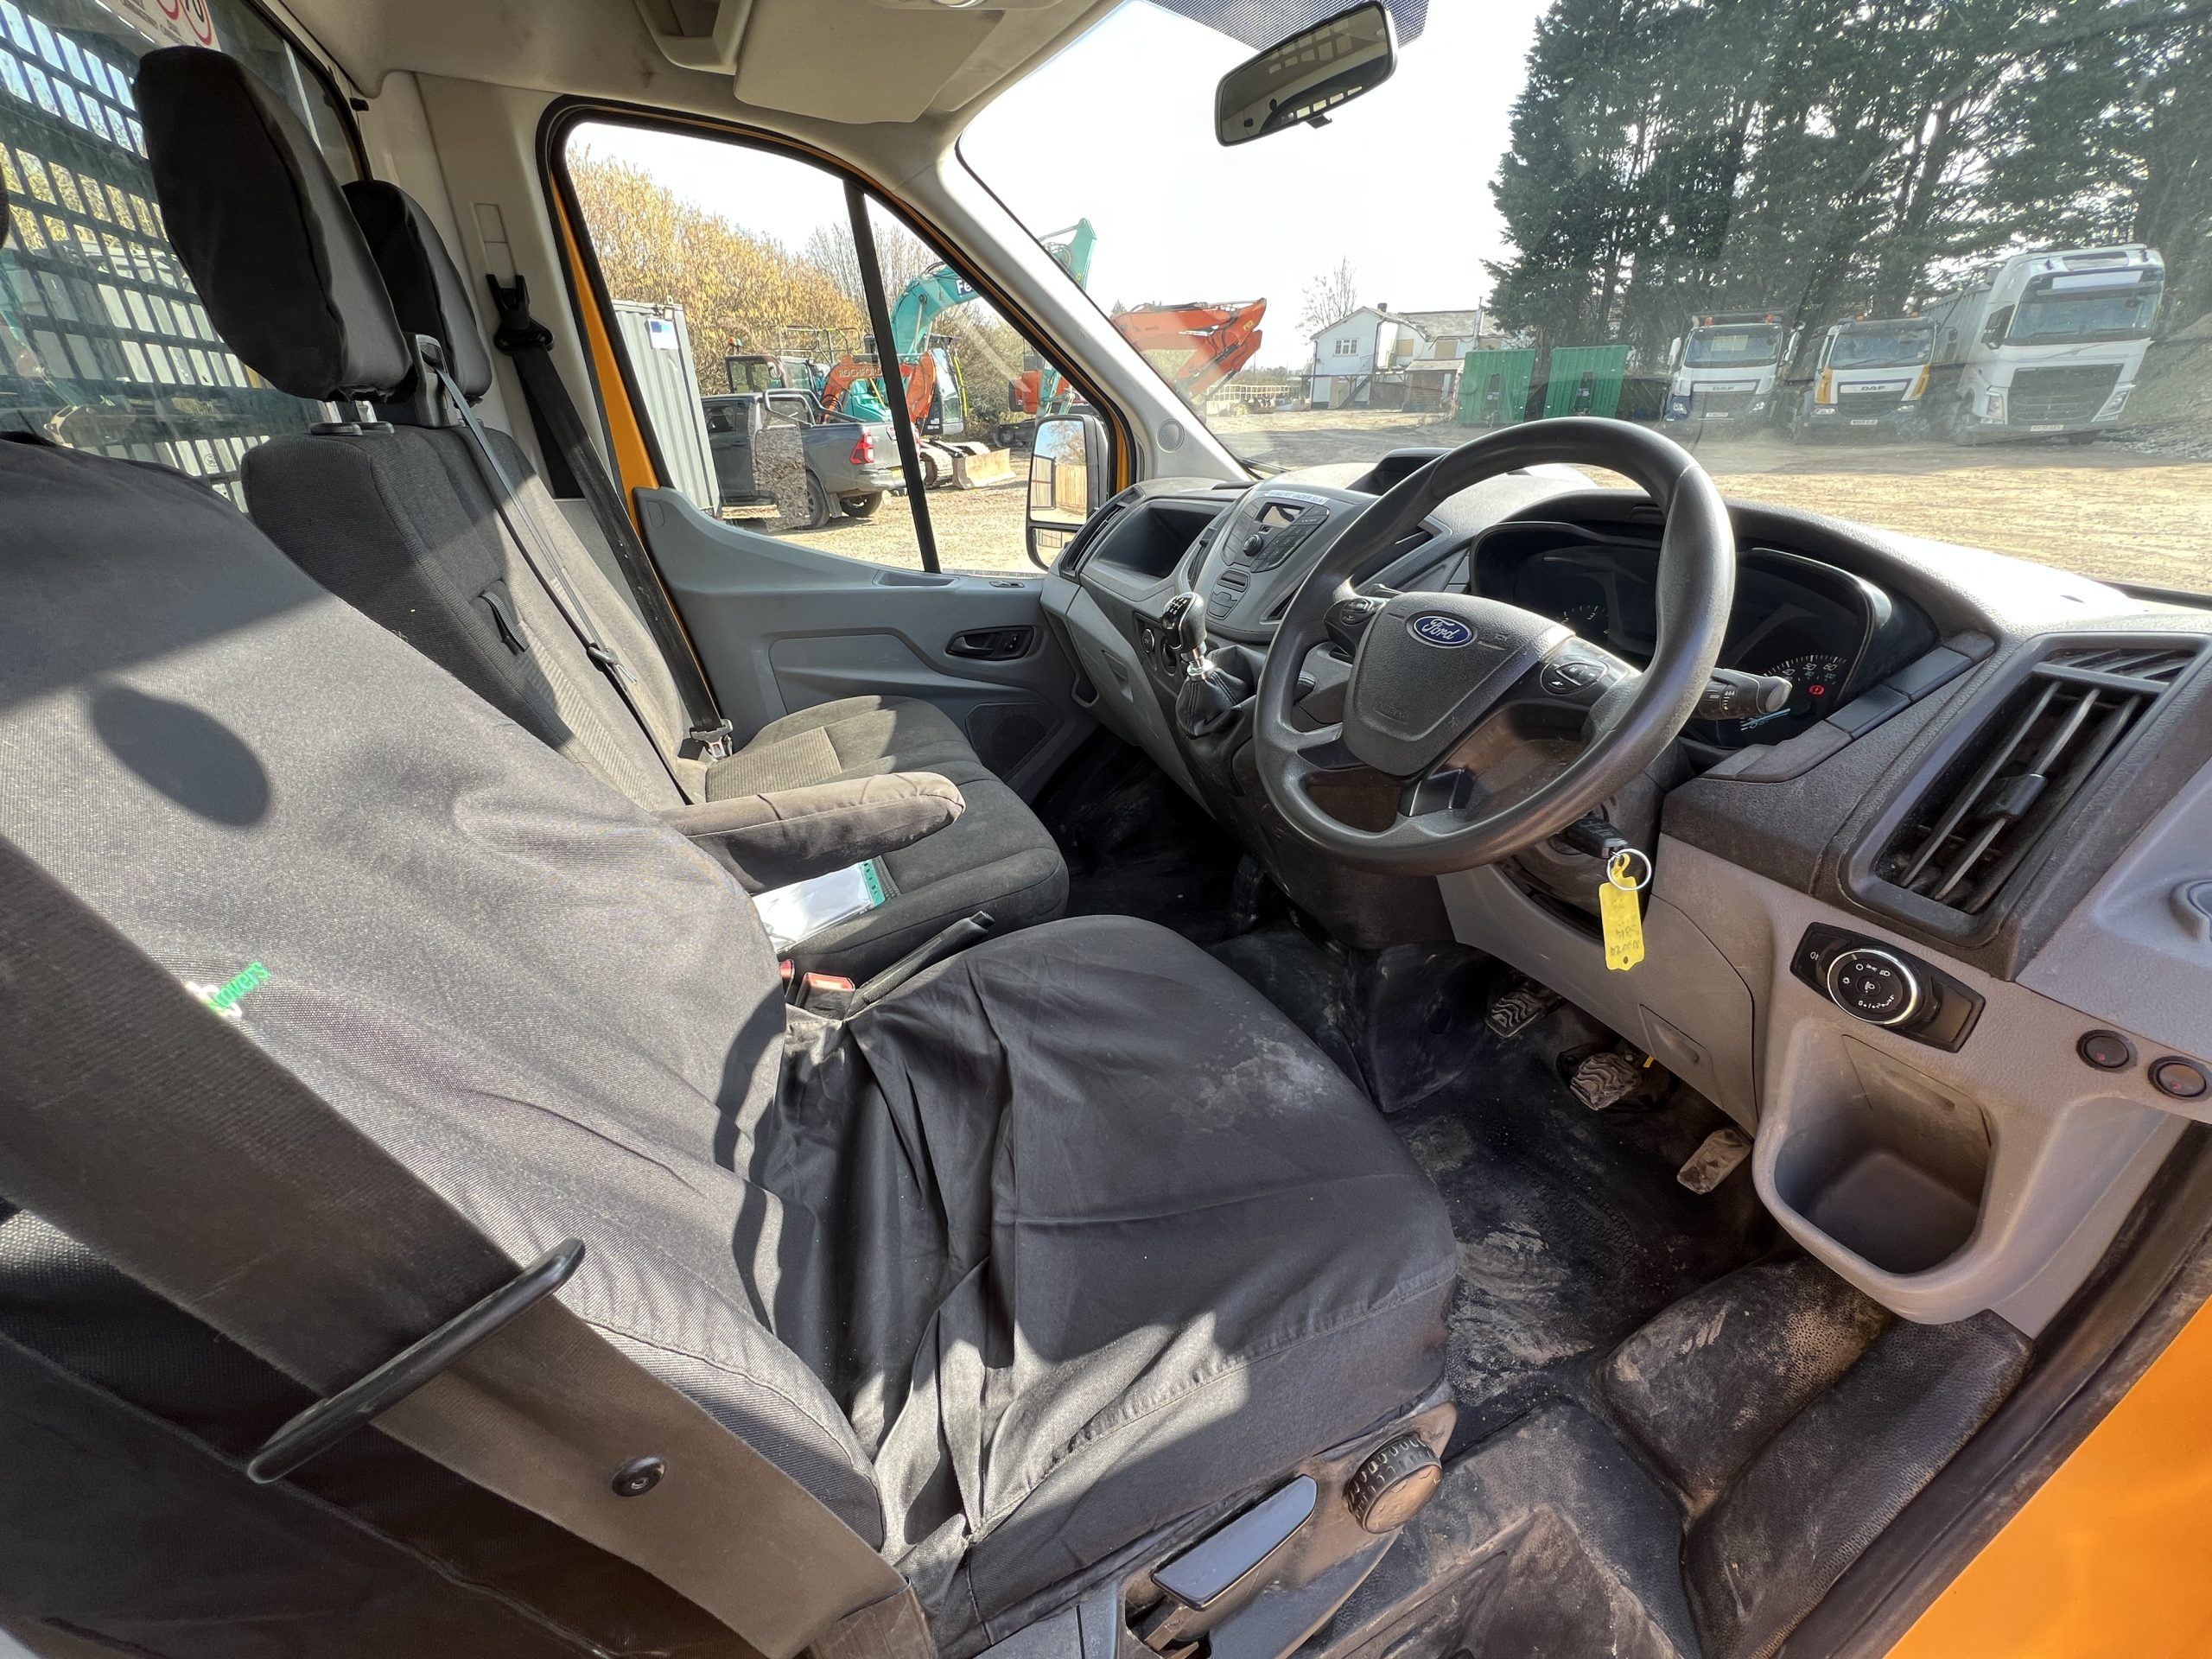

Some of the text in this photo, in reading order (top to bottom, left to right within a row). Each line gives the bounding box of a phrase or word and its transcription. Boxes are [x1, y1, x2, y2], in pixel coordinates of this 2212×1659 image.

[838, 367, 882, 378] ROCHFORD
[1421, 618, 1460, 640] Ford
[1802, 663, 1817, 671] 50
[1822, 663, 1838, 671] 60
